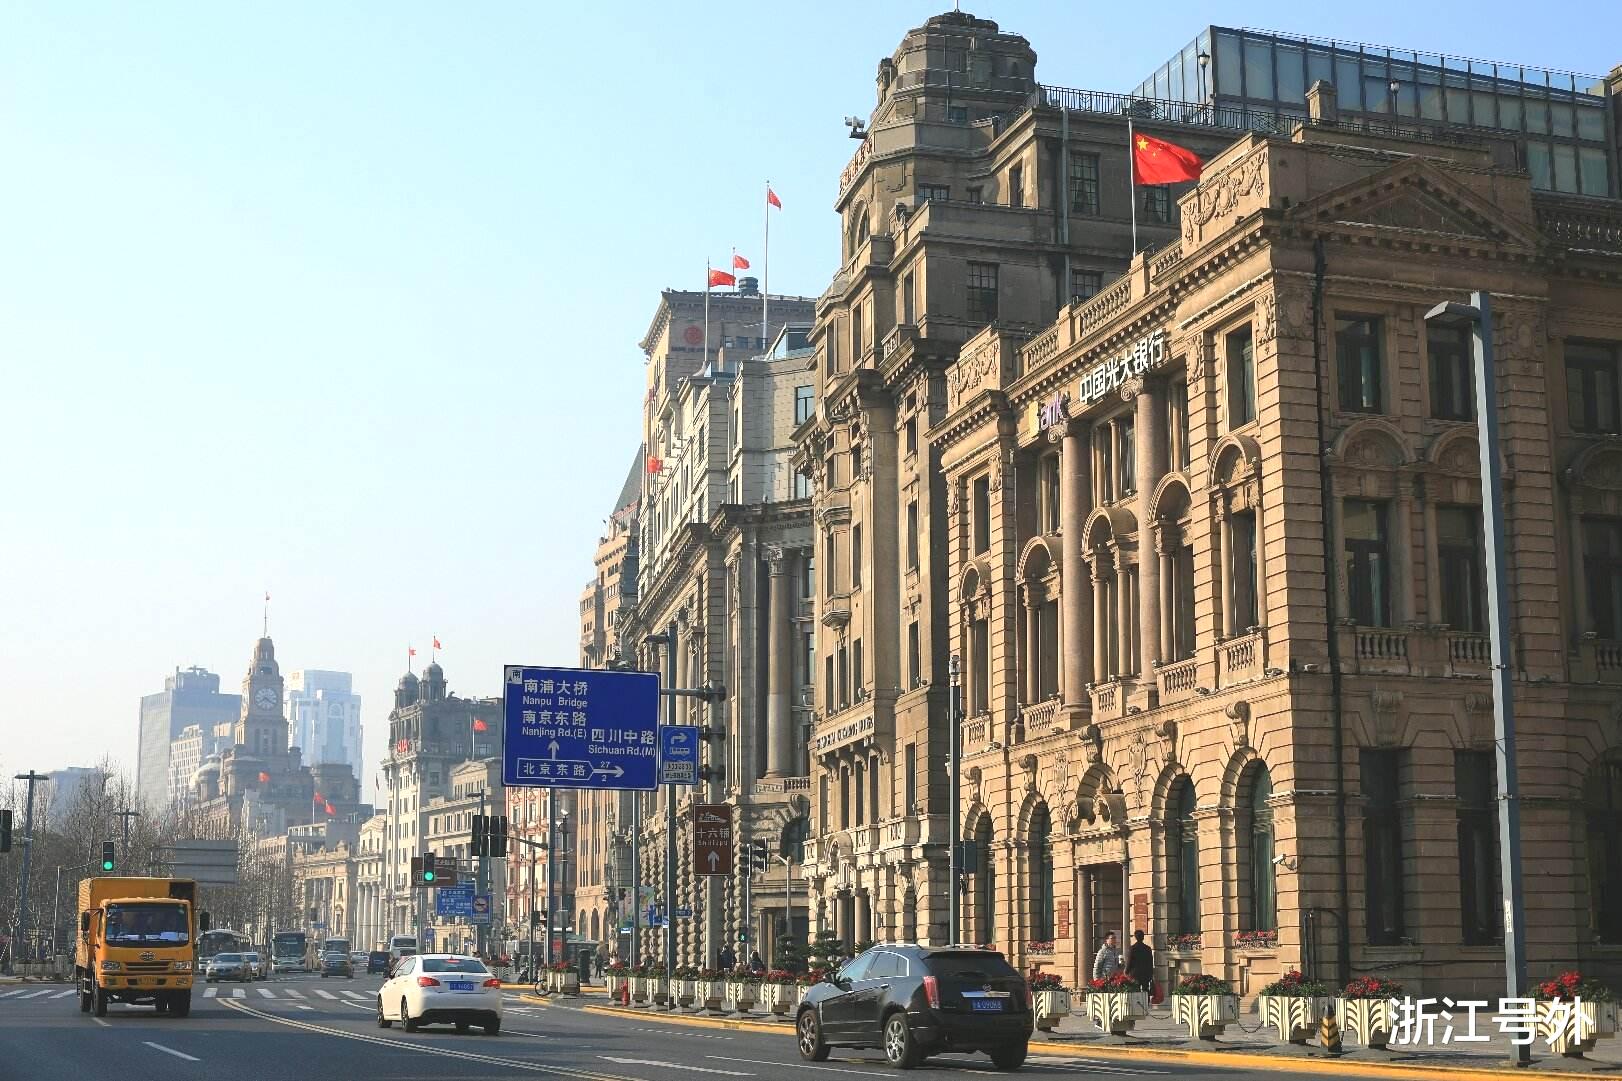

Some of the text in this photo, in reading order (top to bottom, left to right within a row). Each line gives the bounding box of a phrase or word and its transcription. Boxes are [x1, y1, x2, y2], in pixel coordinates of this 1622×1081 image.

[1079, 328, 1166, 405] 中国光大银行
[523, 678, 588, 696] 南浦大桥
[522, 695, 588, 709] Nanpu Bridge
[522, 709, 587, 727] 南京东路
[522, 726, 587, 740] Nanjing Rd.(E)
[591, 728, 656, 745] 四川中路
[588, 744, 656, 758] Sichuan Rd.(M)
[523, 762, 586, 777] 北京东路
[600, 761, 610, 769] 27
[601, 774, 607, 782] 2
